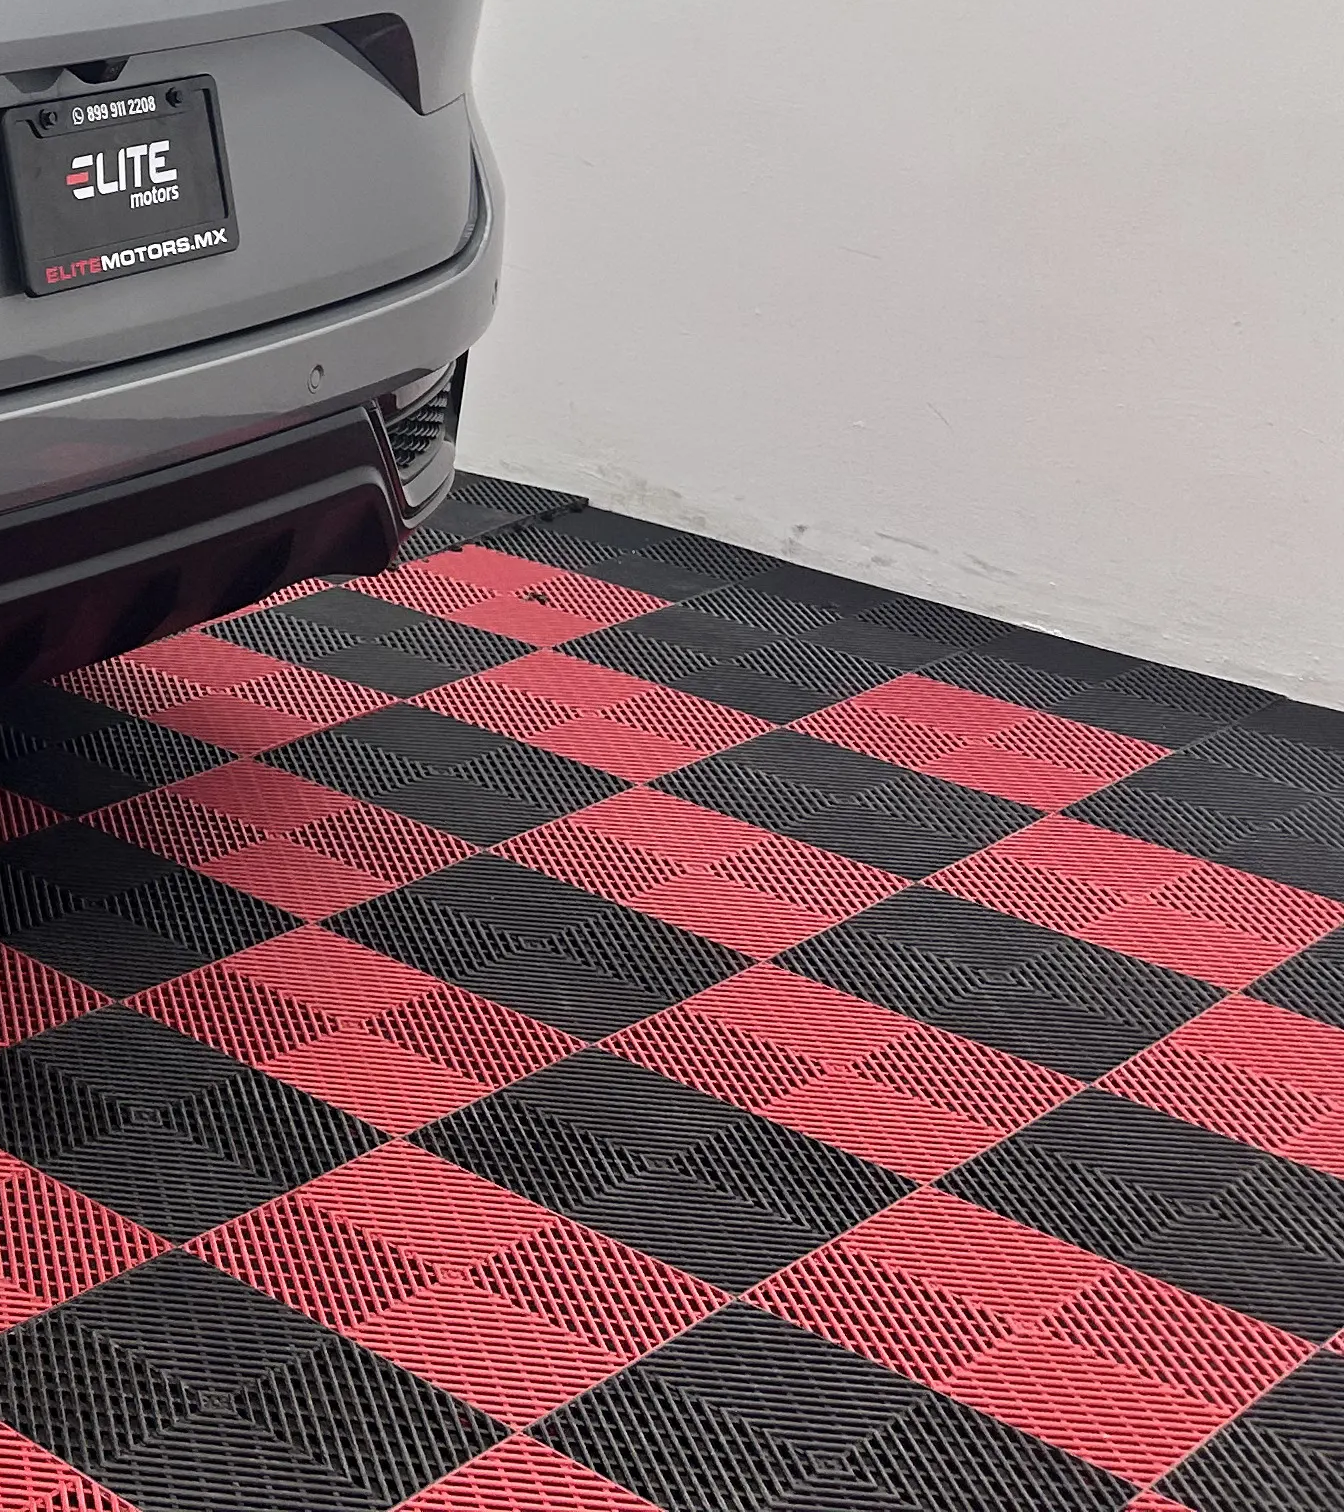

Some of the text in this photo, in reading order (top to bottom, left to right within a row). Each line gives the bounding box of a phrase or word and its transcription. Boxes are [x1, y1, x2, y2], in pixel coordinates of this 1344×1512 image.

[86, 95, 156, 122] 899 911 2208
[65, 139, 178, 200] ELITE
[130, 185, 180, 209] motors
[45, 227, 228, 284] ELITEMOTORS.MX
